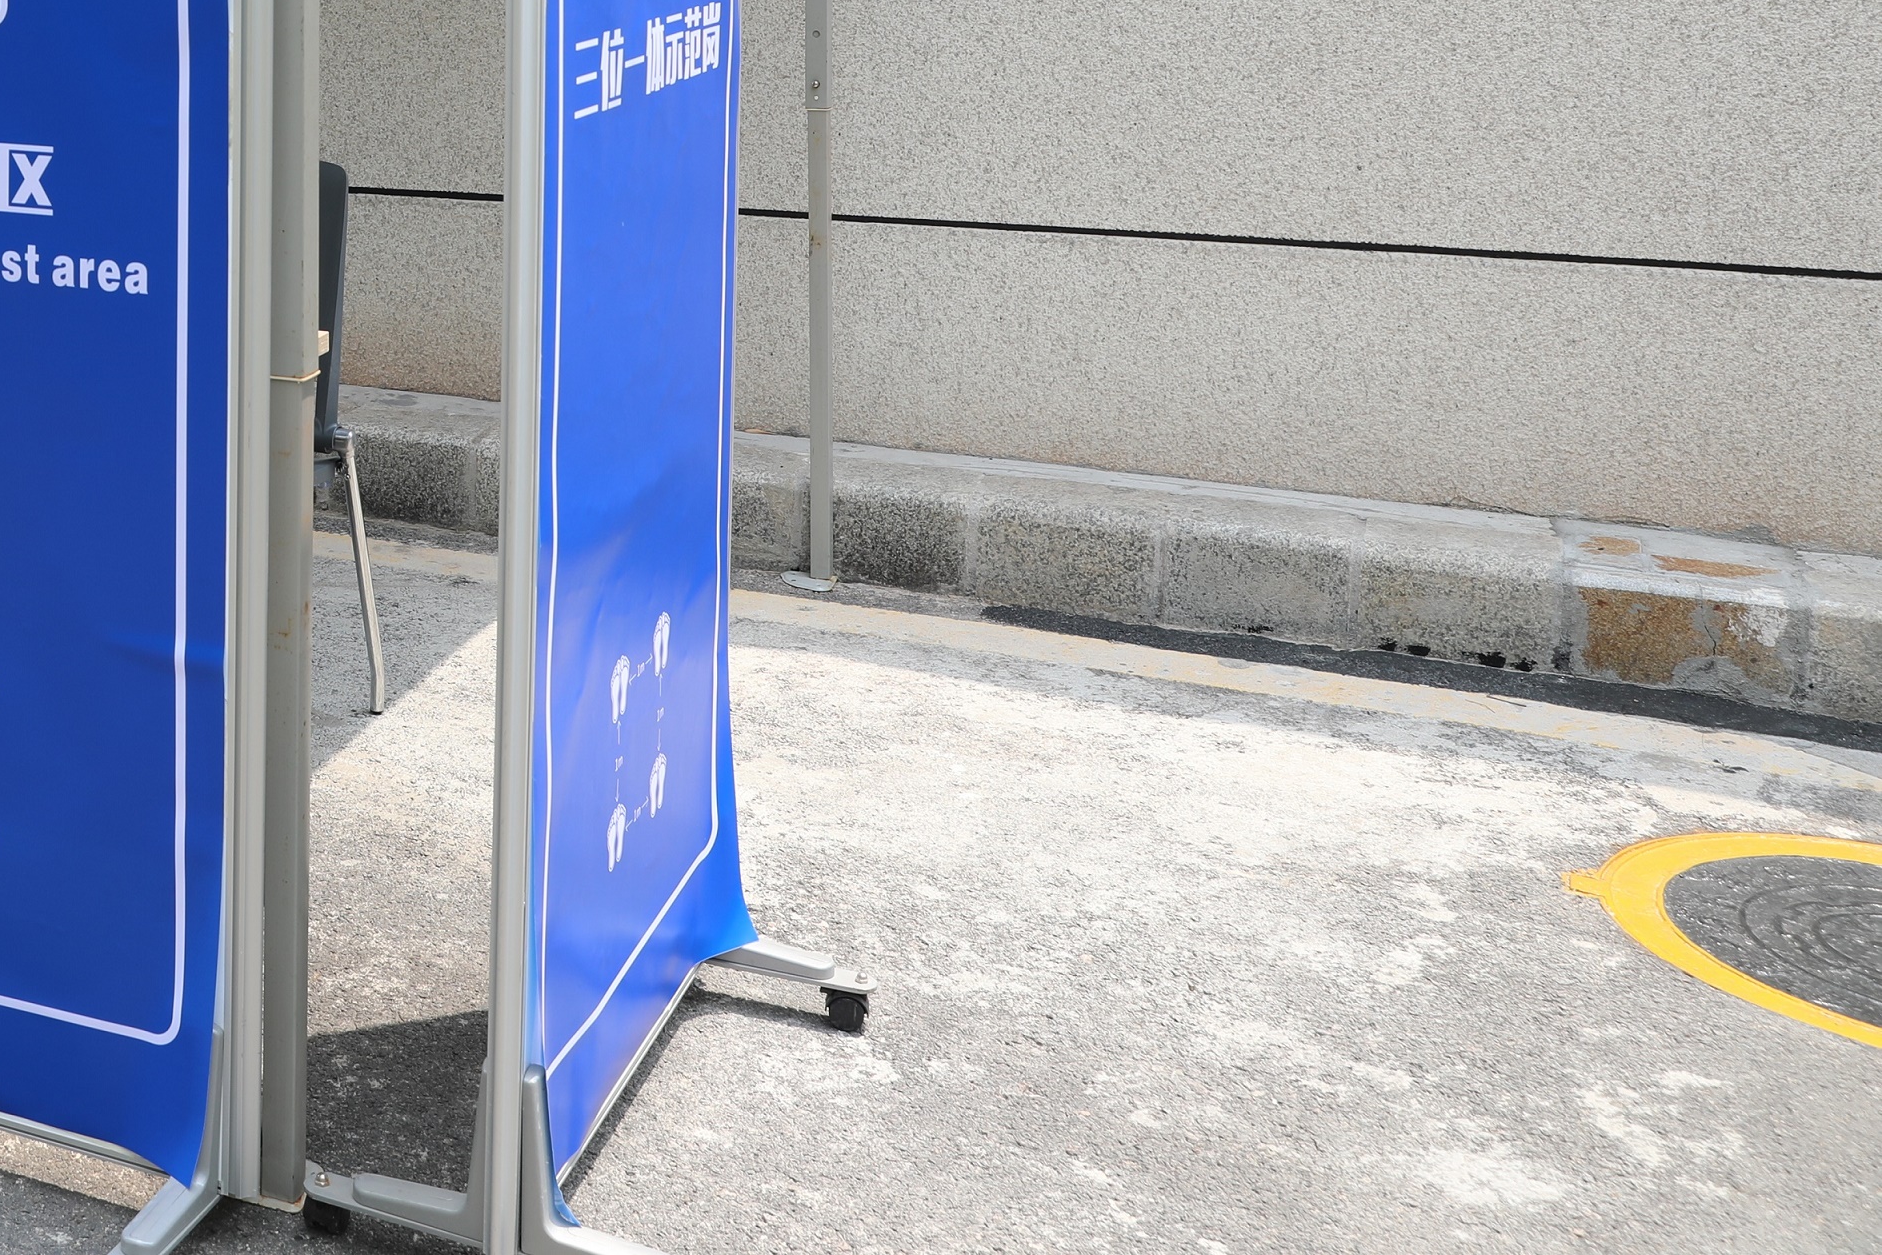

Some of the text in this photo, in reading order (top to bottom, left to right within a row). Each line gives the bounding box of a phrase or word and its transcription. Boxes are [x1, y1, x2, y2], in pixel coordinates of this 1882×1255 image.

[573, 1, 722, 120] 三位一体示范岗
[50, 253, 149, 296] area
